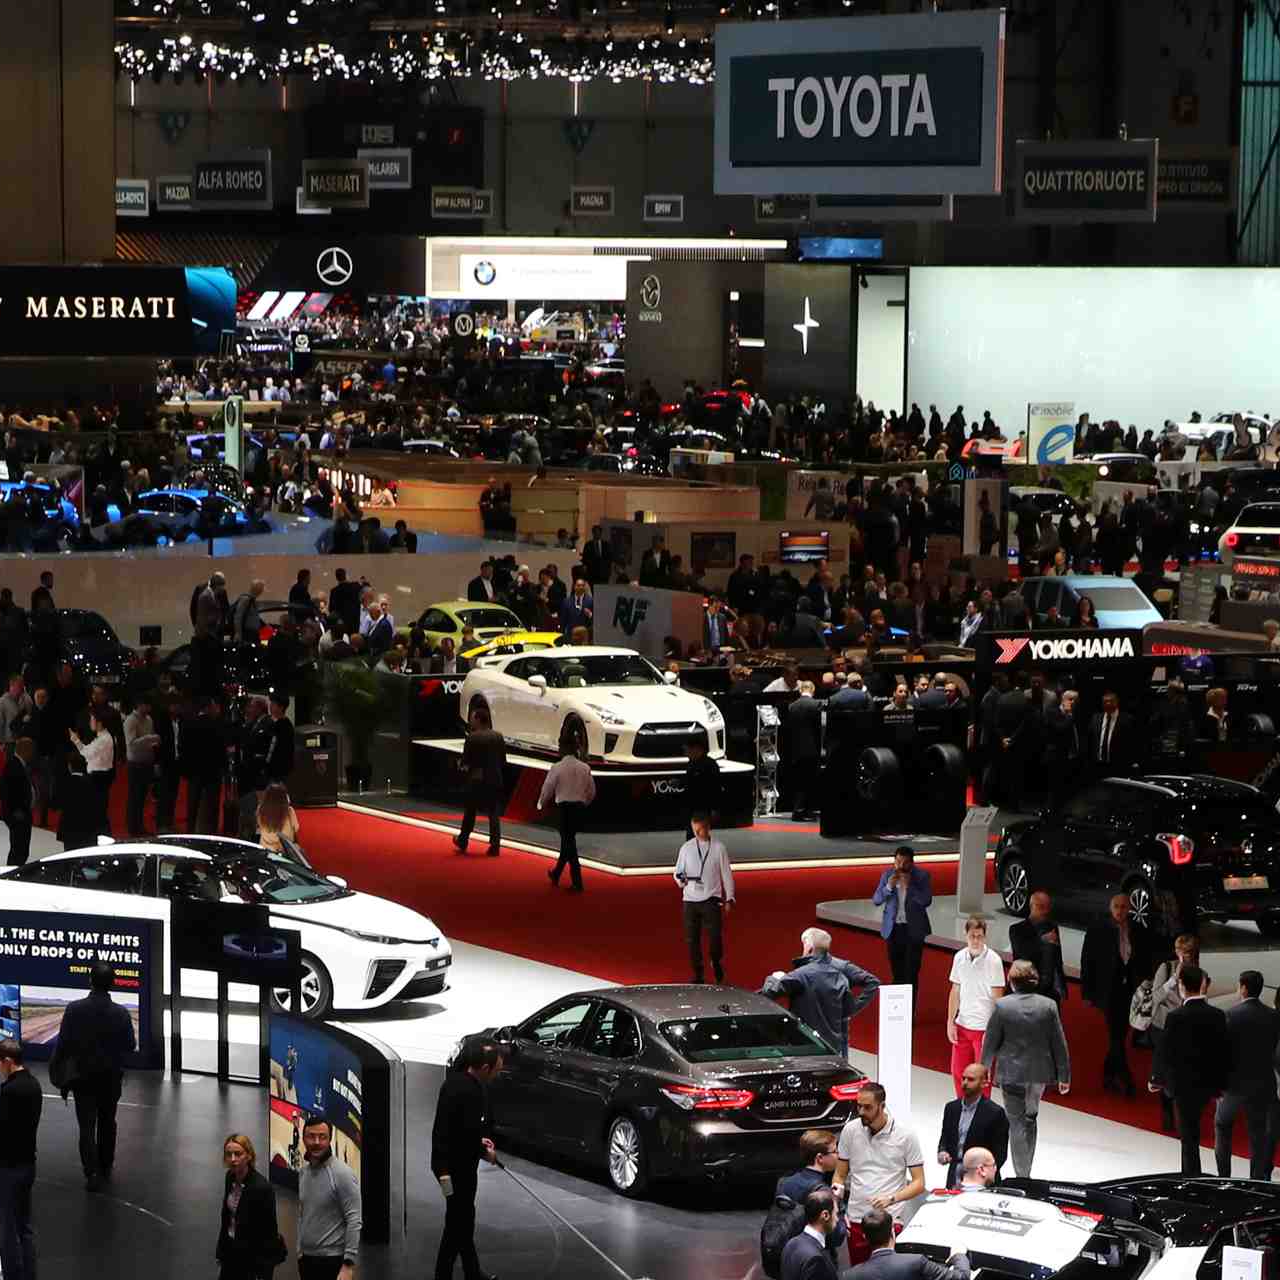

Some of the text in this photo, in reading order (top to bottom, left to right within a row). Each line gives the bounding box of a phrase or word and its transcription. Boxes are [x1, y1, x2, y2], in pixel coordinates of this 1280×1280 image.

[768, 73, 937, 139] TOYOTA
[198, 170, 263, 189] ALFA ROMEO
[310, 174, 360, 193] MASERATI
[1024, 169, 1145, 194] QUATTRORUOTE
[25, 295, 176, 319] MASERATI
[1029, 637, 1135, 661] YOKOHAMA
[11, 928, 35, 940] THE
[39, 930, 64, 942] CAR
[68, 931, 100, 944] THAT
[103, 933, 140, 947] EMITS
[31, 946, 73, 959] DROPS
[77, 949, 94, 961] OF
[97, 951, 143, 964] WATER.
